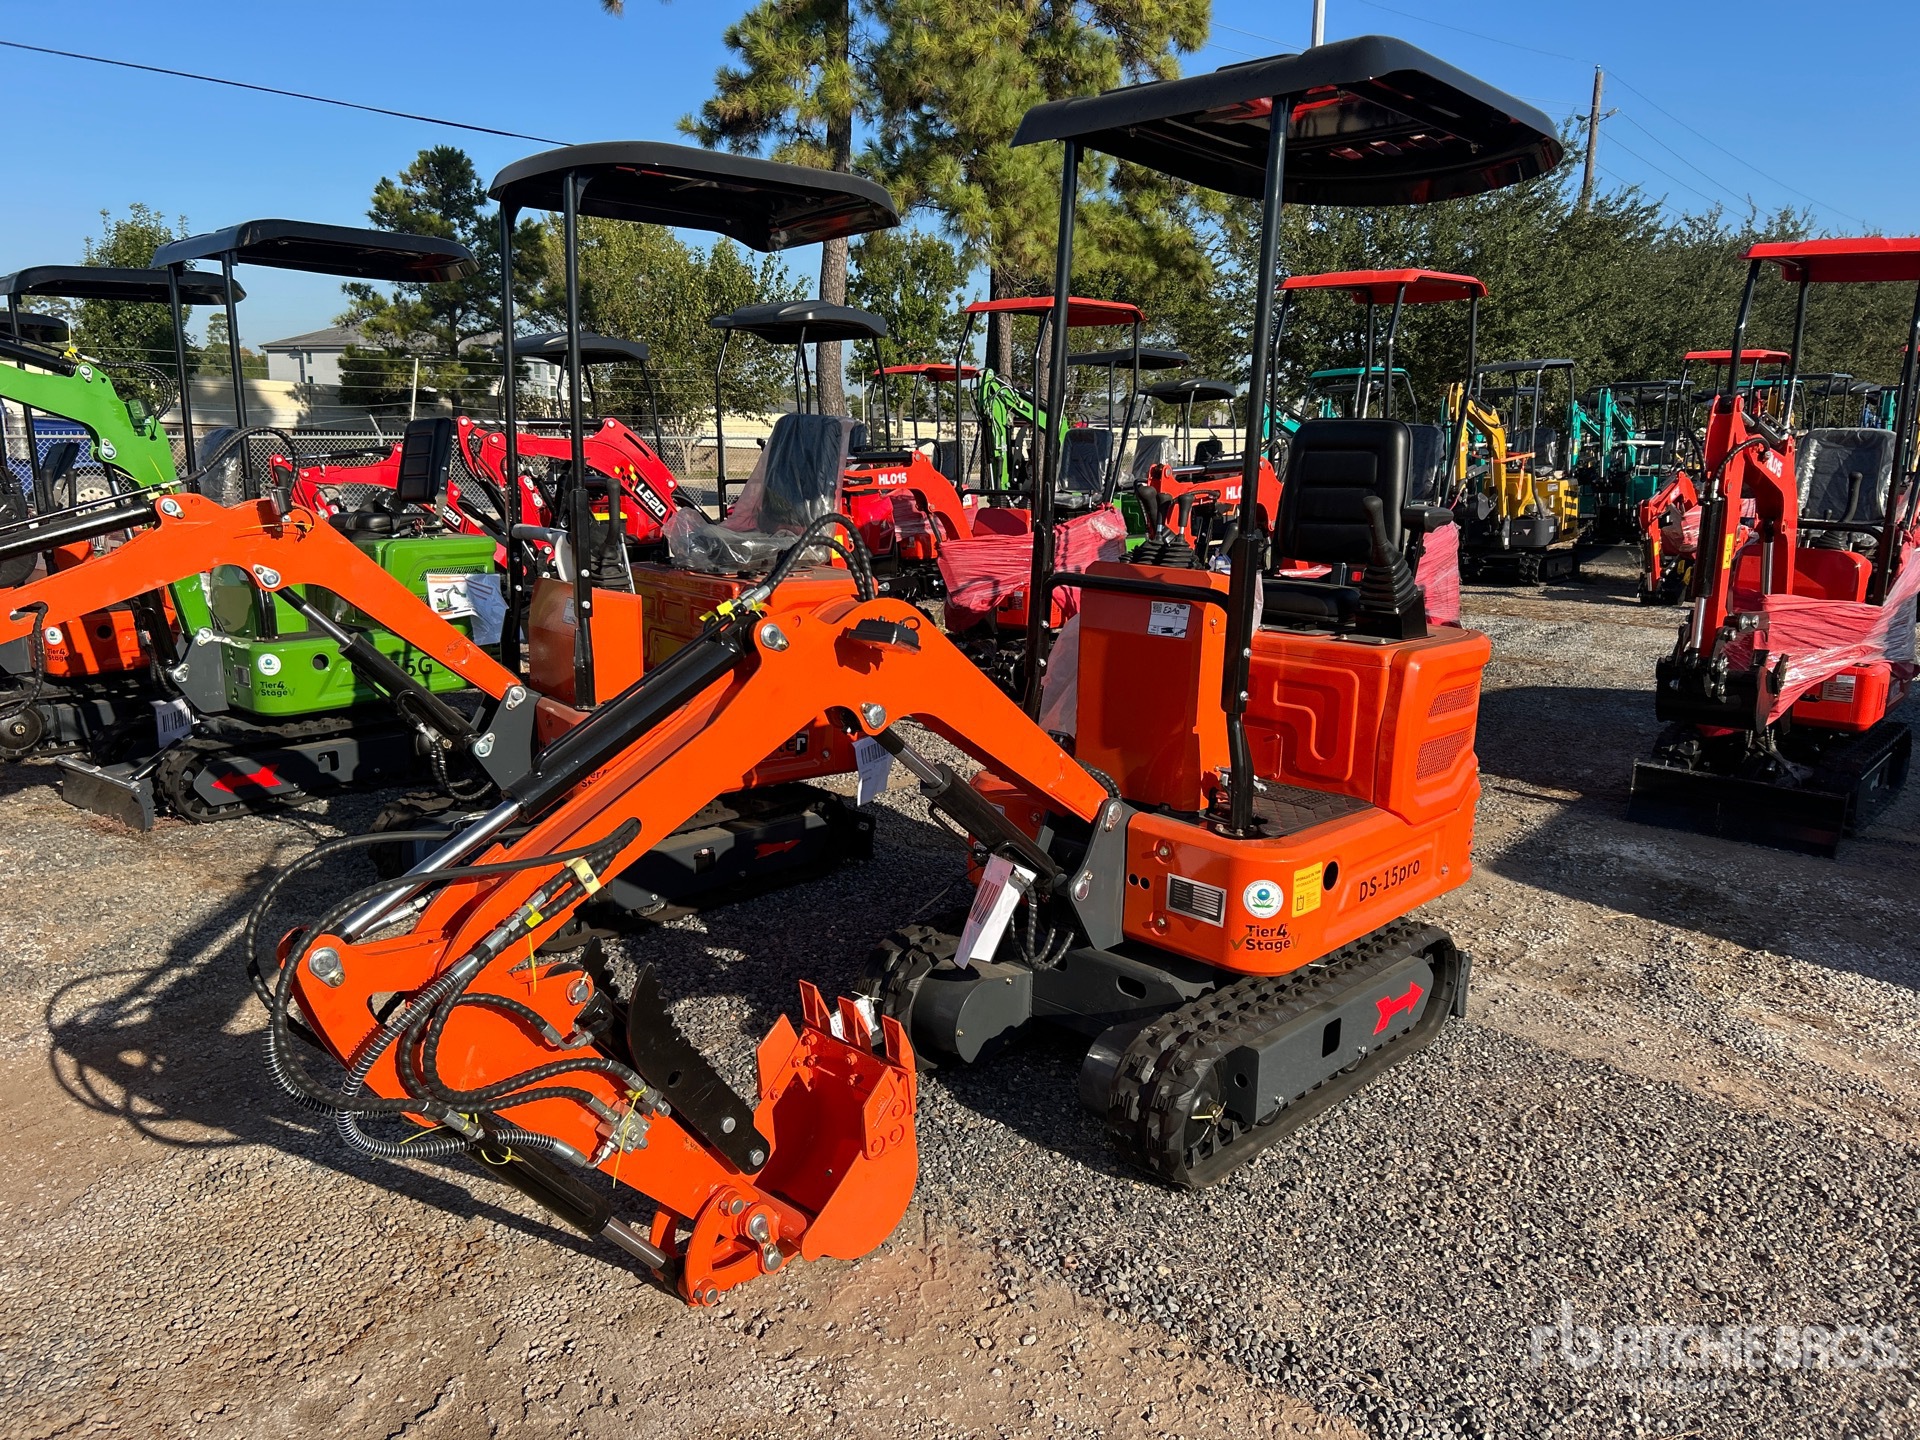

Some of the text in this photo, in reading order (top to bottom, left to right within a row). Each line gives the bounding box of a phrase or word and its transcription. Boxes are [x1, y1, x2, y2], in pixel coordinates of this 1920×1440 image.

[635, 483, 667, 517] LE20
[1359, 859, 1420, 903] DS-15pro
[1245, 938, 1291, 954] Stage
